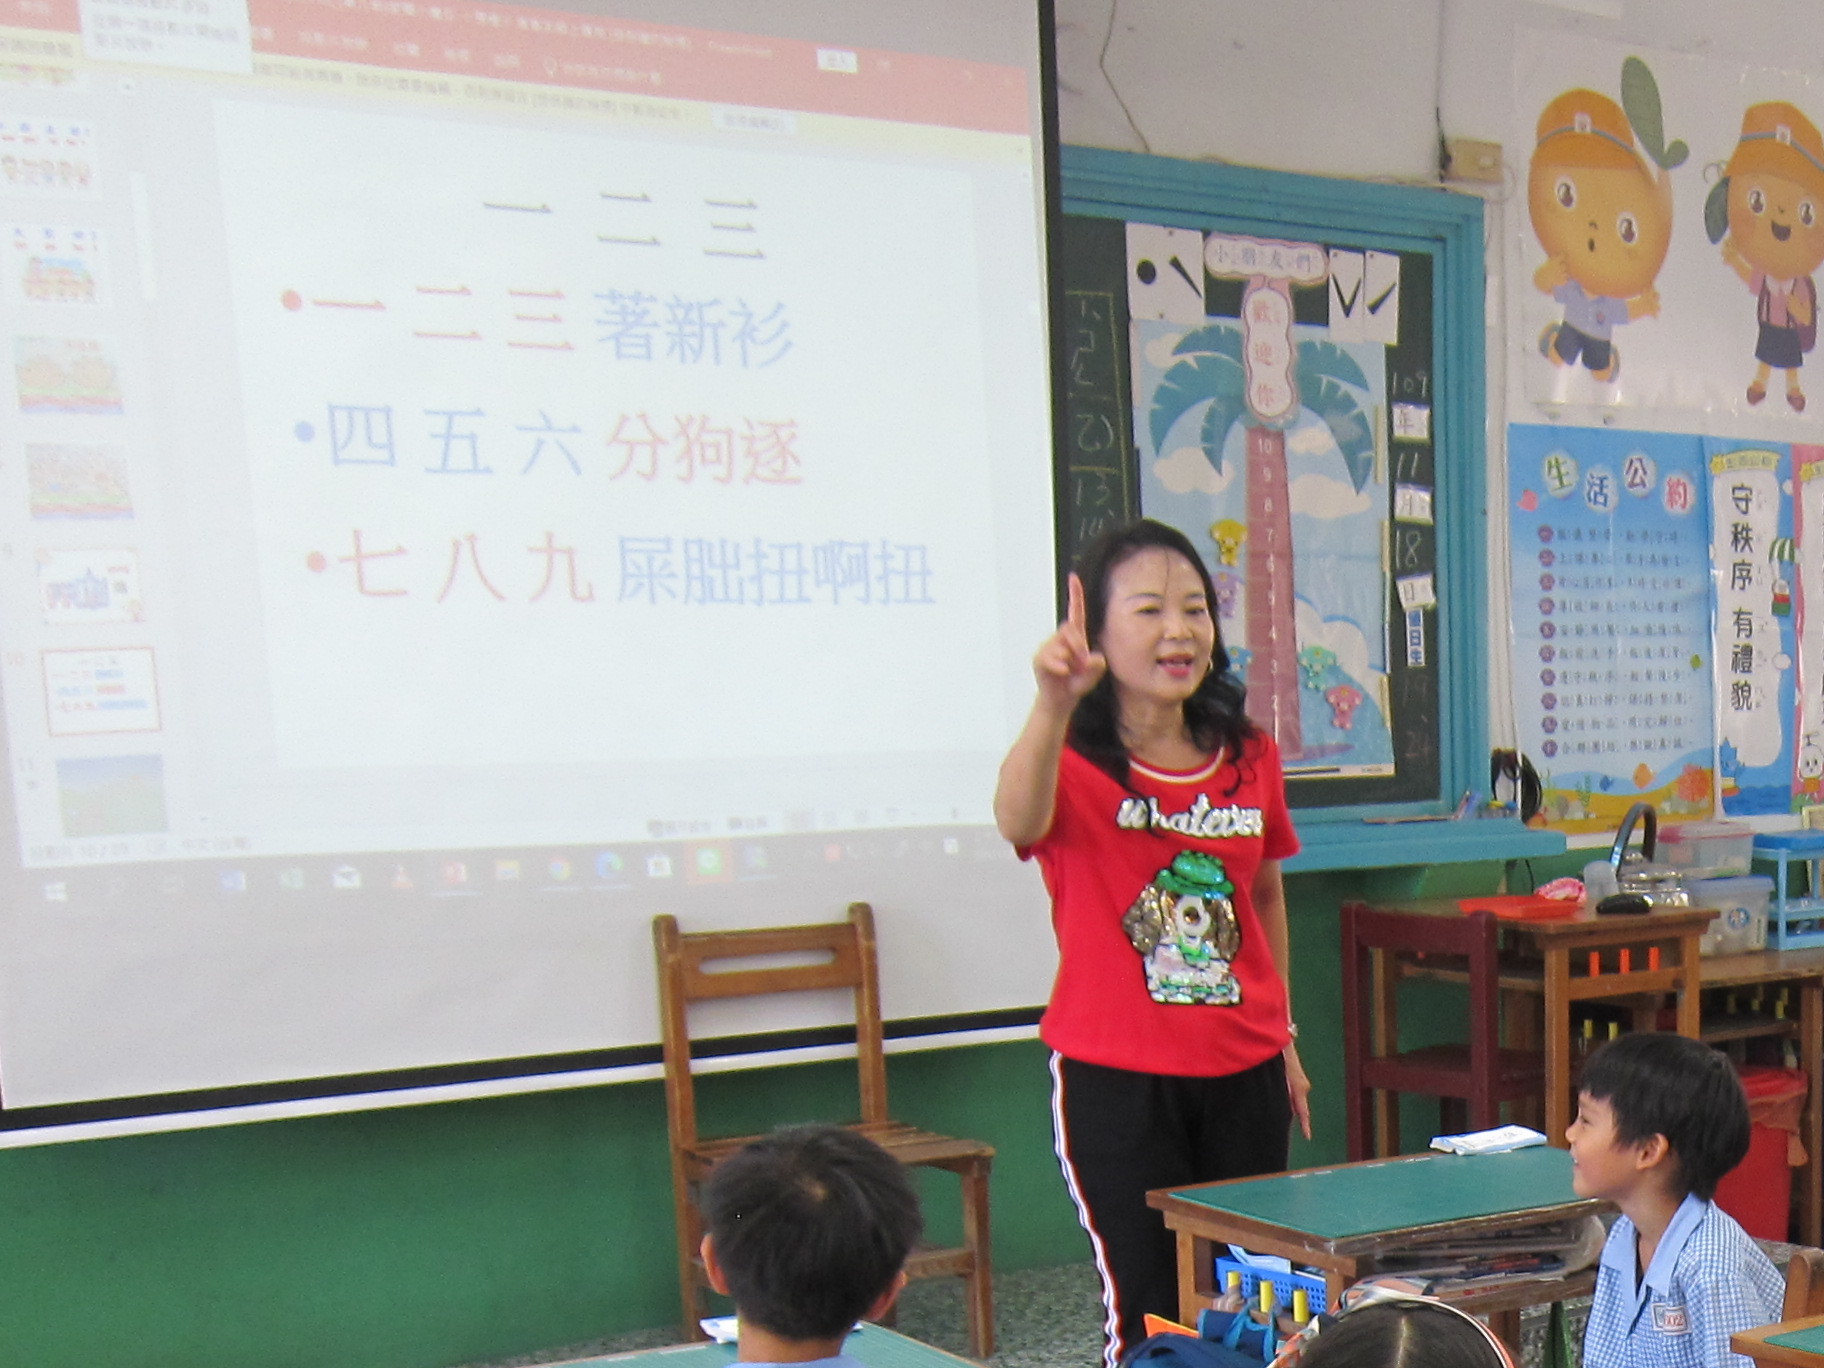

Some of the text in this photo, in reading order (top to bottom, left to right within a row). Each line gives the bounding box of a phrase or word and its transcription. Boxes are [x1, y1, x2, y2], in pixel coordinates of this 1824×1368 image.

[599, 192, 661, 248] 二
[704, 199, 766, 260] 三
[412, 284, 481, 341] 二
[506, 287, 574, 354] 三
[595, 289, 794, 369] 著新衫
[328, 402, 804, 487] 四 五 六 分狗逐
[1544, 455, 1689, 510] 生活公約
[338, 528, 409, 601] 七
[436, 534, 507, 602] 八
[527, 530, 595, 604] 九
[1730, 483, 1755, 592] 守秩序
[1730, 607, 1755, 712] 有禮貌
